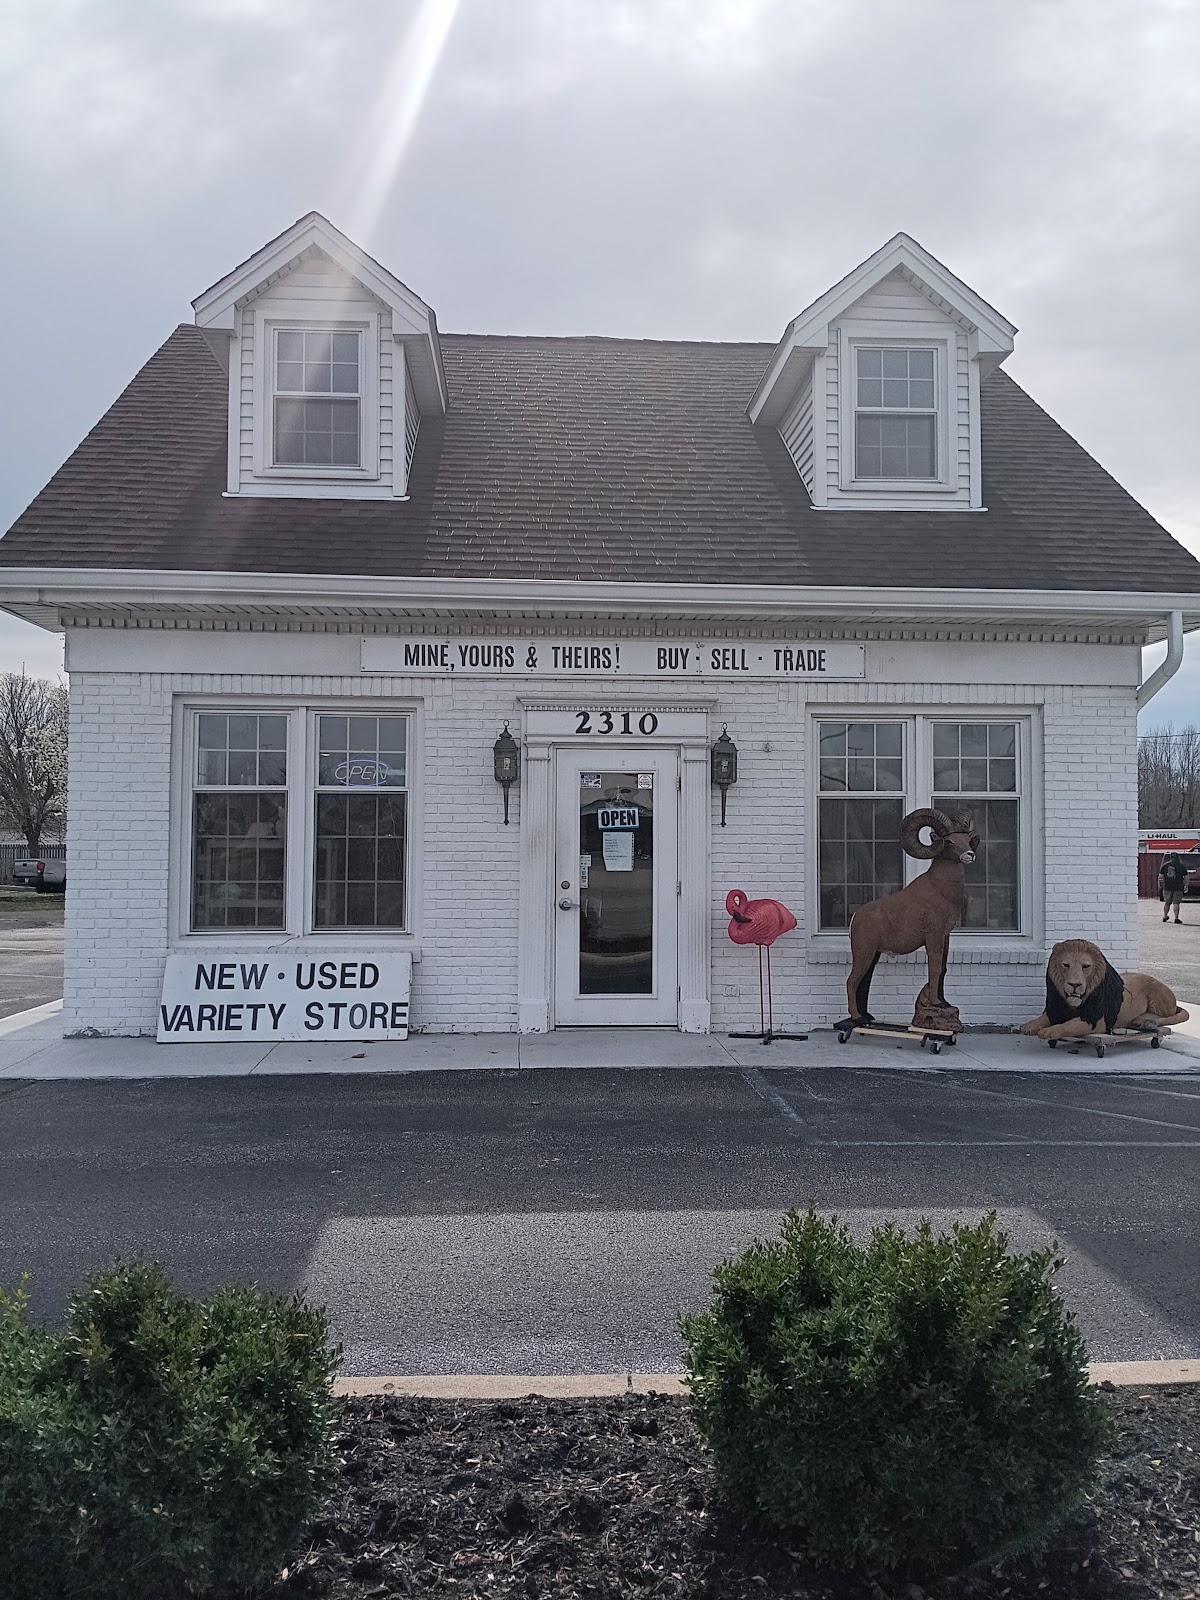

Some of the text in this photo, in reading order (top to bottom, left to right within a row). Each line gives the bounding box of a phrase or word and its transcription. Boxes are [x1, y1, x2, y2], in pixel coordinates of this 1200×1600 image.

[458, 644, 515, 668] YOURS
[525, 646, 538, 669] &
[552, 645, 620, 670] THEIRS!
[657, 647, 826, 672] BUY SELL TRADE
[575, 711, 658, 735] 2310
[335, 765, 389, 780] OPEN
[600, 809, 637, 827] OPEN
[195, 961, 380, 990] NEW USED
[160, 1001, 409, 1032] VARIETY STORE
